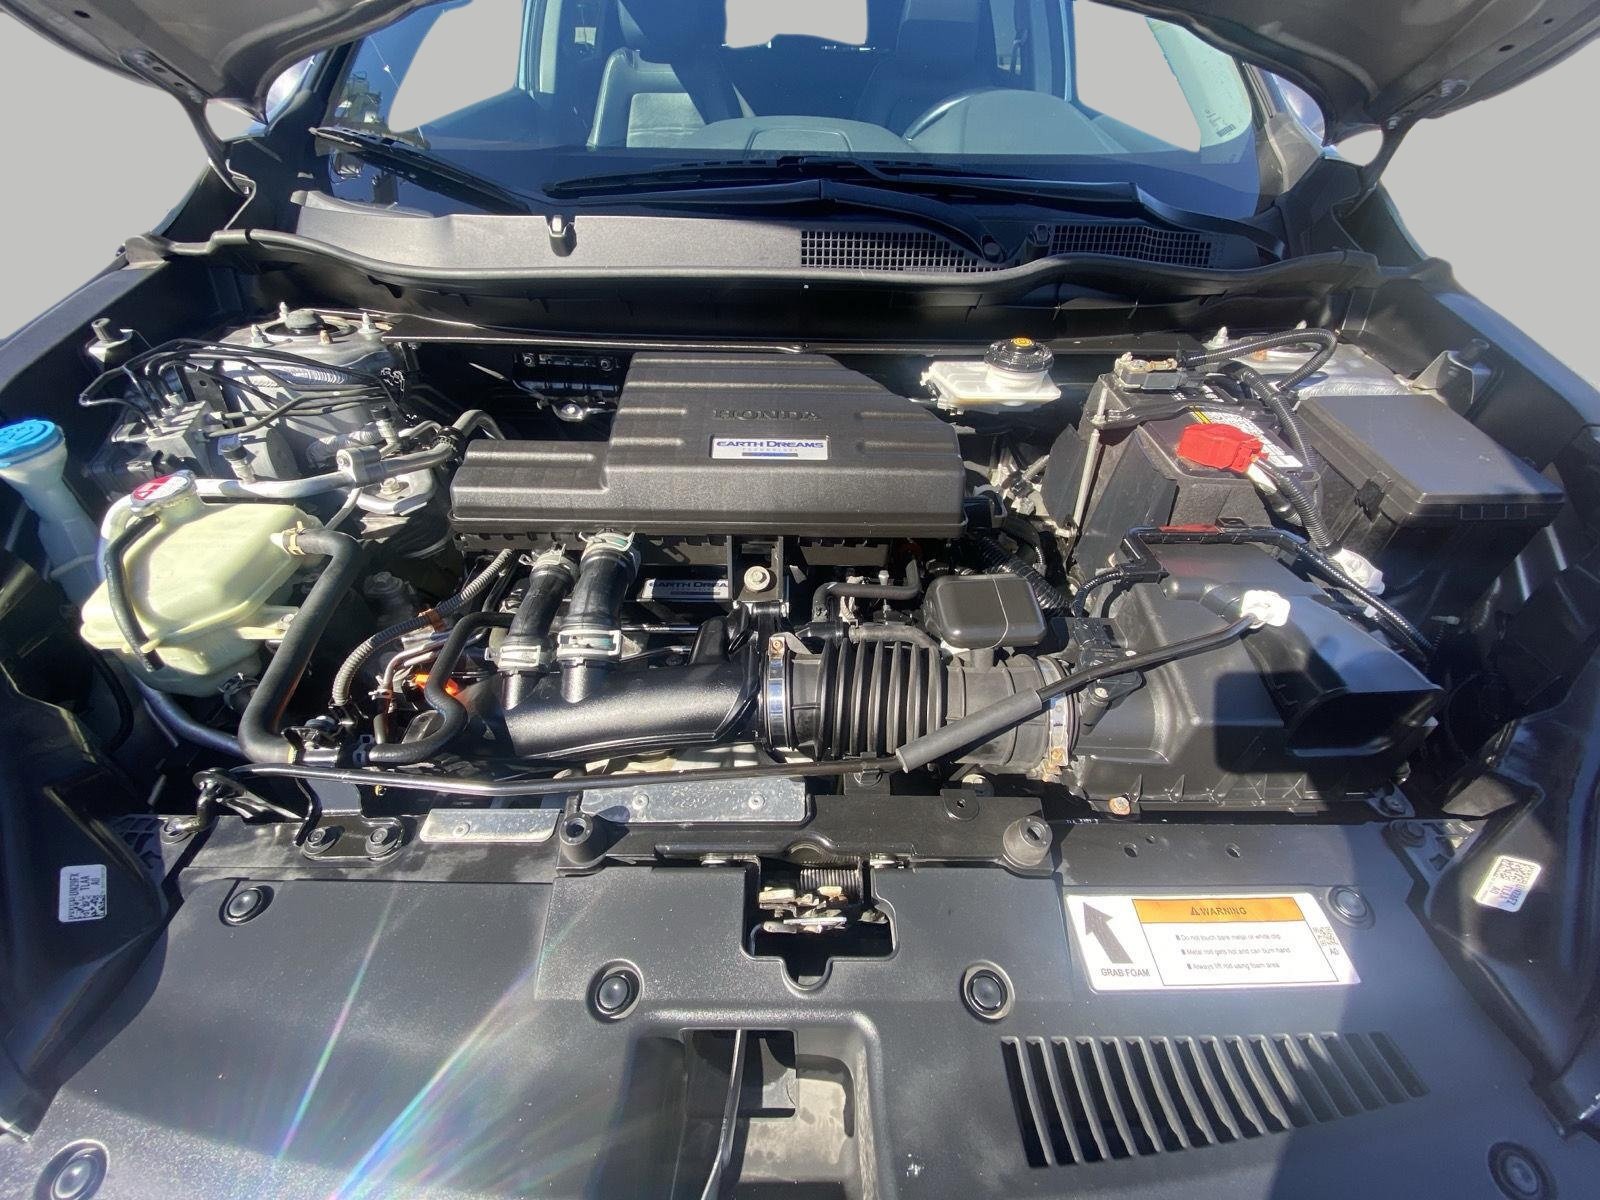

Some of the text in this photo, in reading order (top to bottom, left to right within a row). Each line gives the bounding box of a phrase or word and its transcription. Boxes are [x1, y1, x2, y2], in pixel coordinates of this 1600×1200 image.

[712, 408, 822, 421] HONDA
[766, 440, 824, 449] DREAMS
[1199, 907, 1247, 916] WARNING
[1100, 968, 1151, 977] GRAB FOAM
